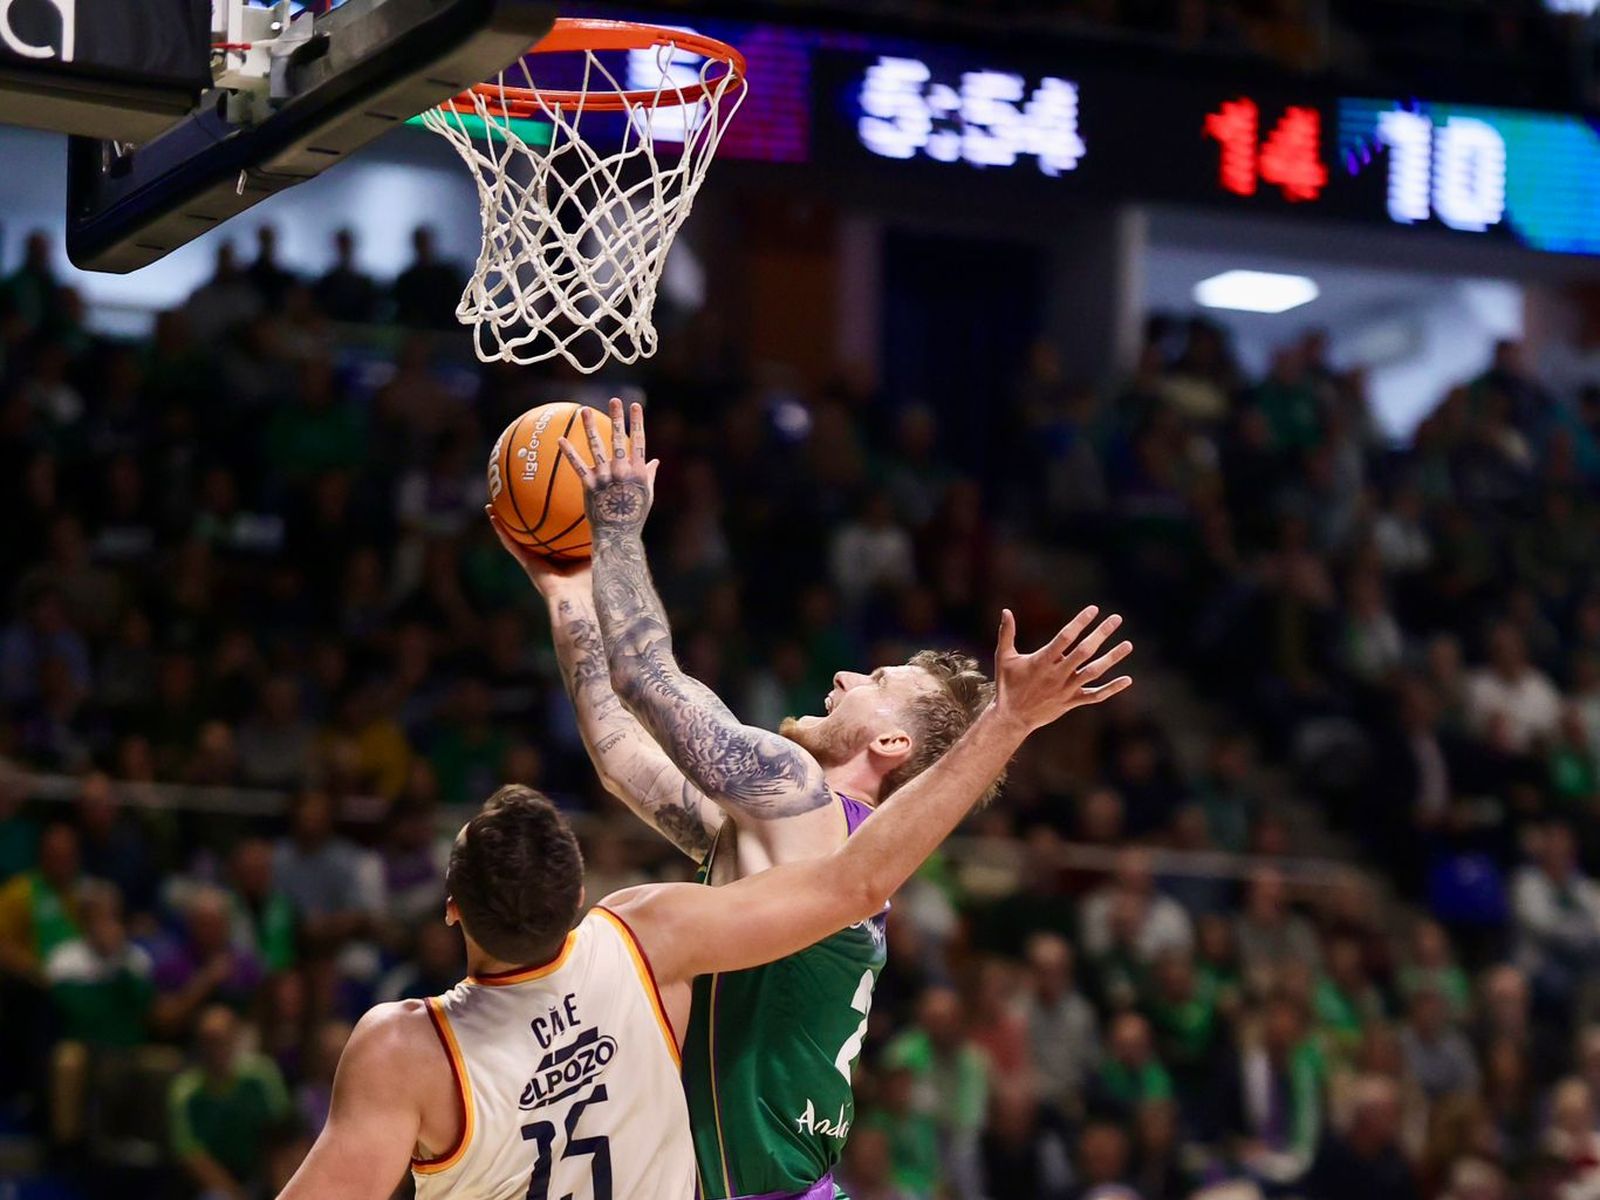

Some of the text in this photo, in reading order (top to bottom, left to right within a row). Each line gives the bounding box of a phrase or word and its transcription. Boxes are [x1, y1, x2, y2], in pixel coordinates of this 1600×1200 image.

[860, 56, 1086, 177] 5:54
[1204, 97, 1328, 201] 14
[1376, 108, 1506, 232] 10
